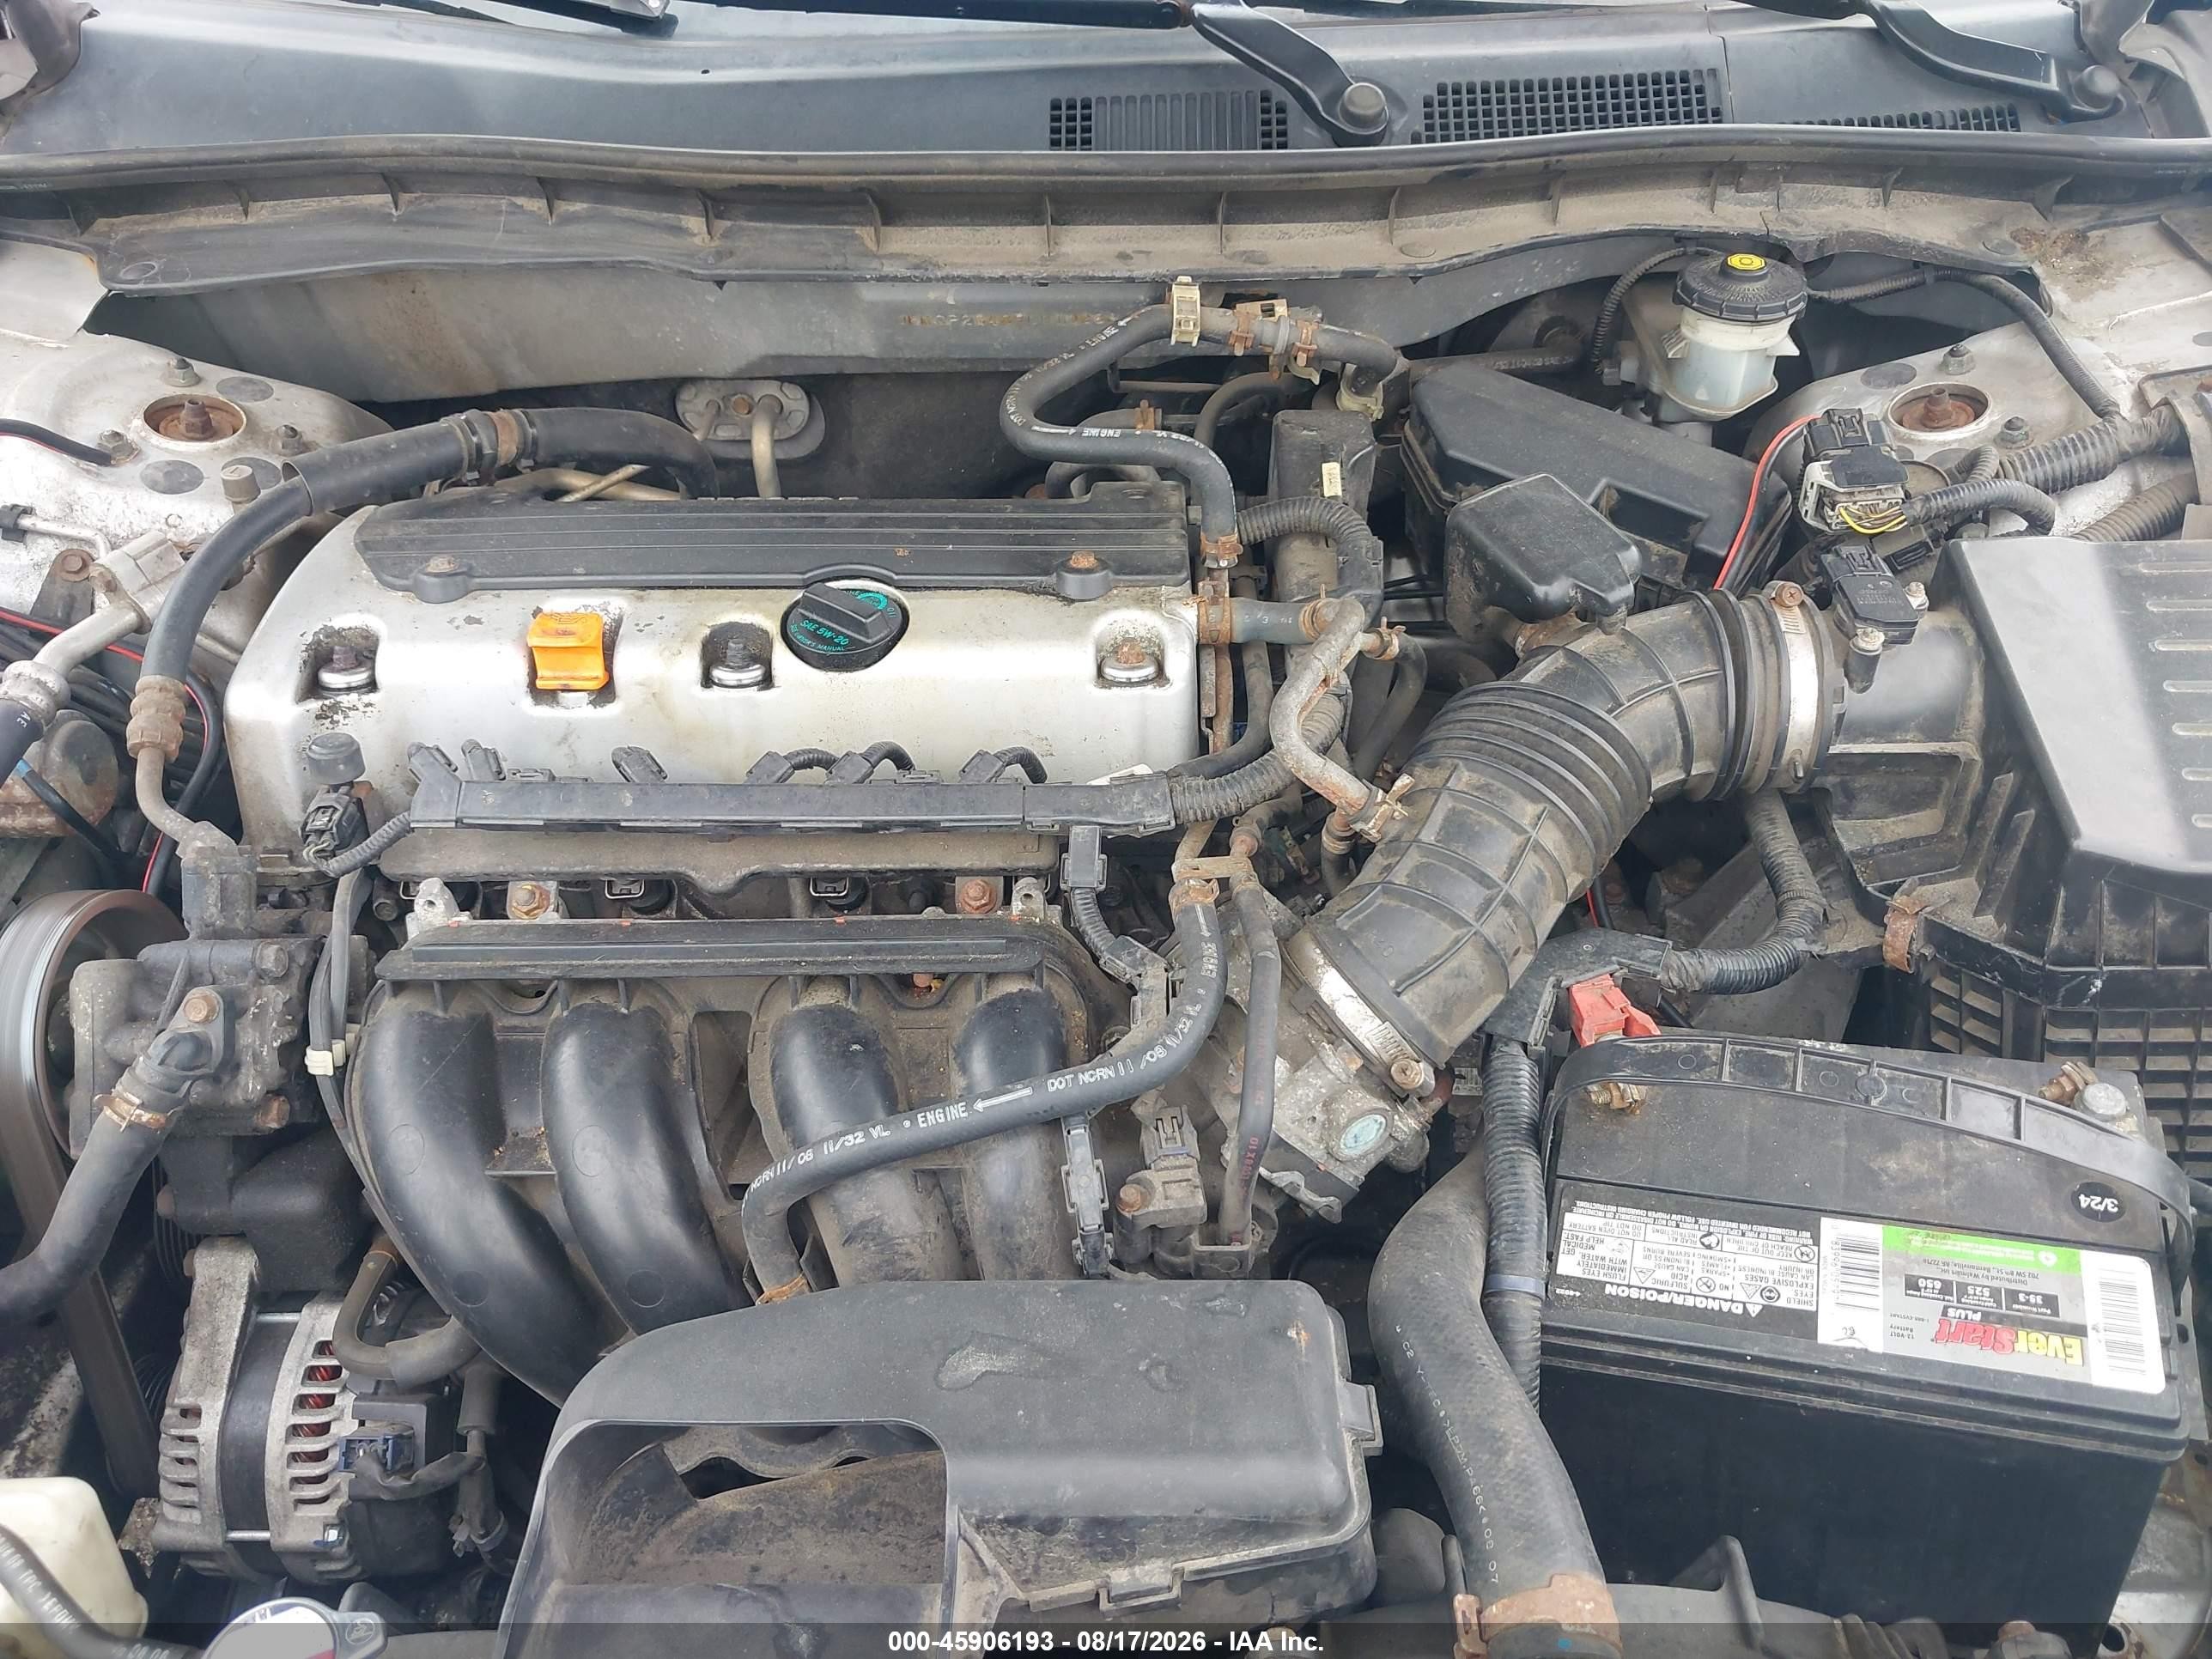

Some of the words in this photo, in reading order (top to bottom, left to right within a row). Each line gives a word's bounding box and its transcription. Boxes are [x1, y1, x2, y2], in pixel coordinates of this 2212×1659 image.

[1082, 428, 1121, 438] ENGINE
[800, 619, 818, 631] SAE
[1165, 1017, 1193, 1049] 11/32
[1185, 1004, 1202, 1018] VL
[1201, 941, 1218, 978] ENGINE
[1048, 1074, 1074, 1091] DOT
[1078, 1066, 1115, 1085] NCRN
[823, 1131, 866, 1154] 11/32
[870, 1124, 891, 1139] VL
[917, 1101, 969, 1128] ENGINE
[2079, 1194, 2118, 1212] 3/24
[1561, 1239, 1595, 1250] MEDICAL
[1585, 1235, 1604, 1243] HELP
[1560, 1246, 1575, 1255] GET
[1576, 1259, 1626, 1272] IMMEDIATELY
[1778, 1264, 1802, 1273] INJURY
[1581, 1267, 1600, 1277] EYES
[1602, 1270, 1626, 1280] FLUSH
[1670, 1272, 1688, 1280] ACID
[1950, 1269, 1980, 1279] Walmart
[1650, 1278, 1688, 1289] SULFURIC
[1743, 1273, 1769, 1283] GASES
[1771, 1277, 1814, 1289] EXPLOSIVE
[1916, 1277, 1942, 1290] 650
[1990, 1274, 2027, 1285] Distributed
[1966, 1285, 1990, 1297] 525
[1603, 1282, 1744, 1315] DANGER/POISON
[1785, 1296, 1813, 1306] SHIELD
[1946, 1307, 1982, 1321] PLUS
[1888, 1322, 1913, 1332] Battery
[1932, 1317, 2086, 1365] EverStart
[1401, 1340, 1414, 1358] C2
[1488, 1560, 1499, 1583] 07
